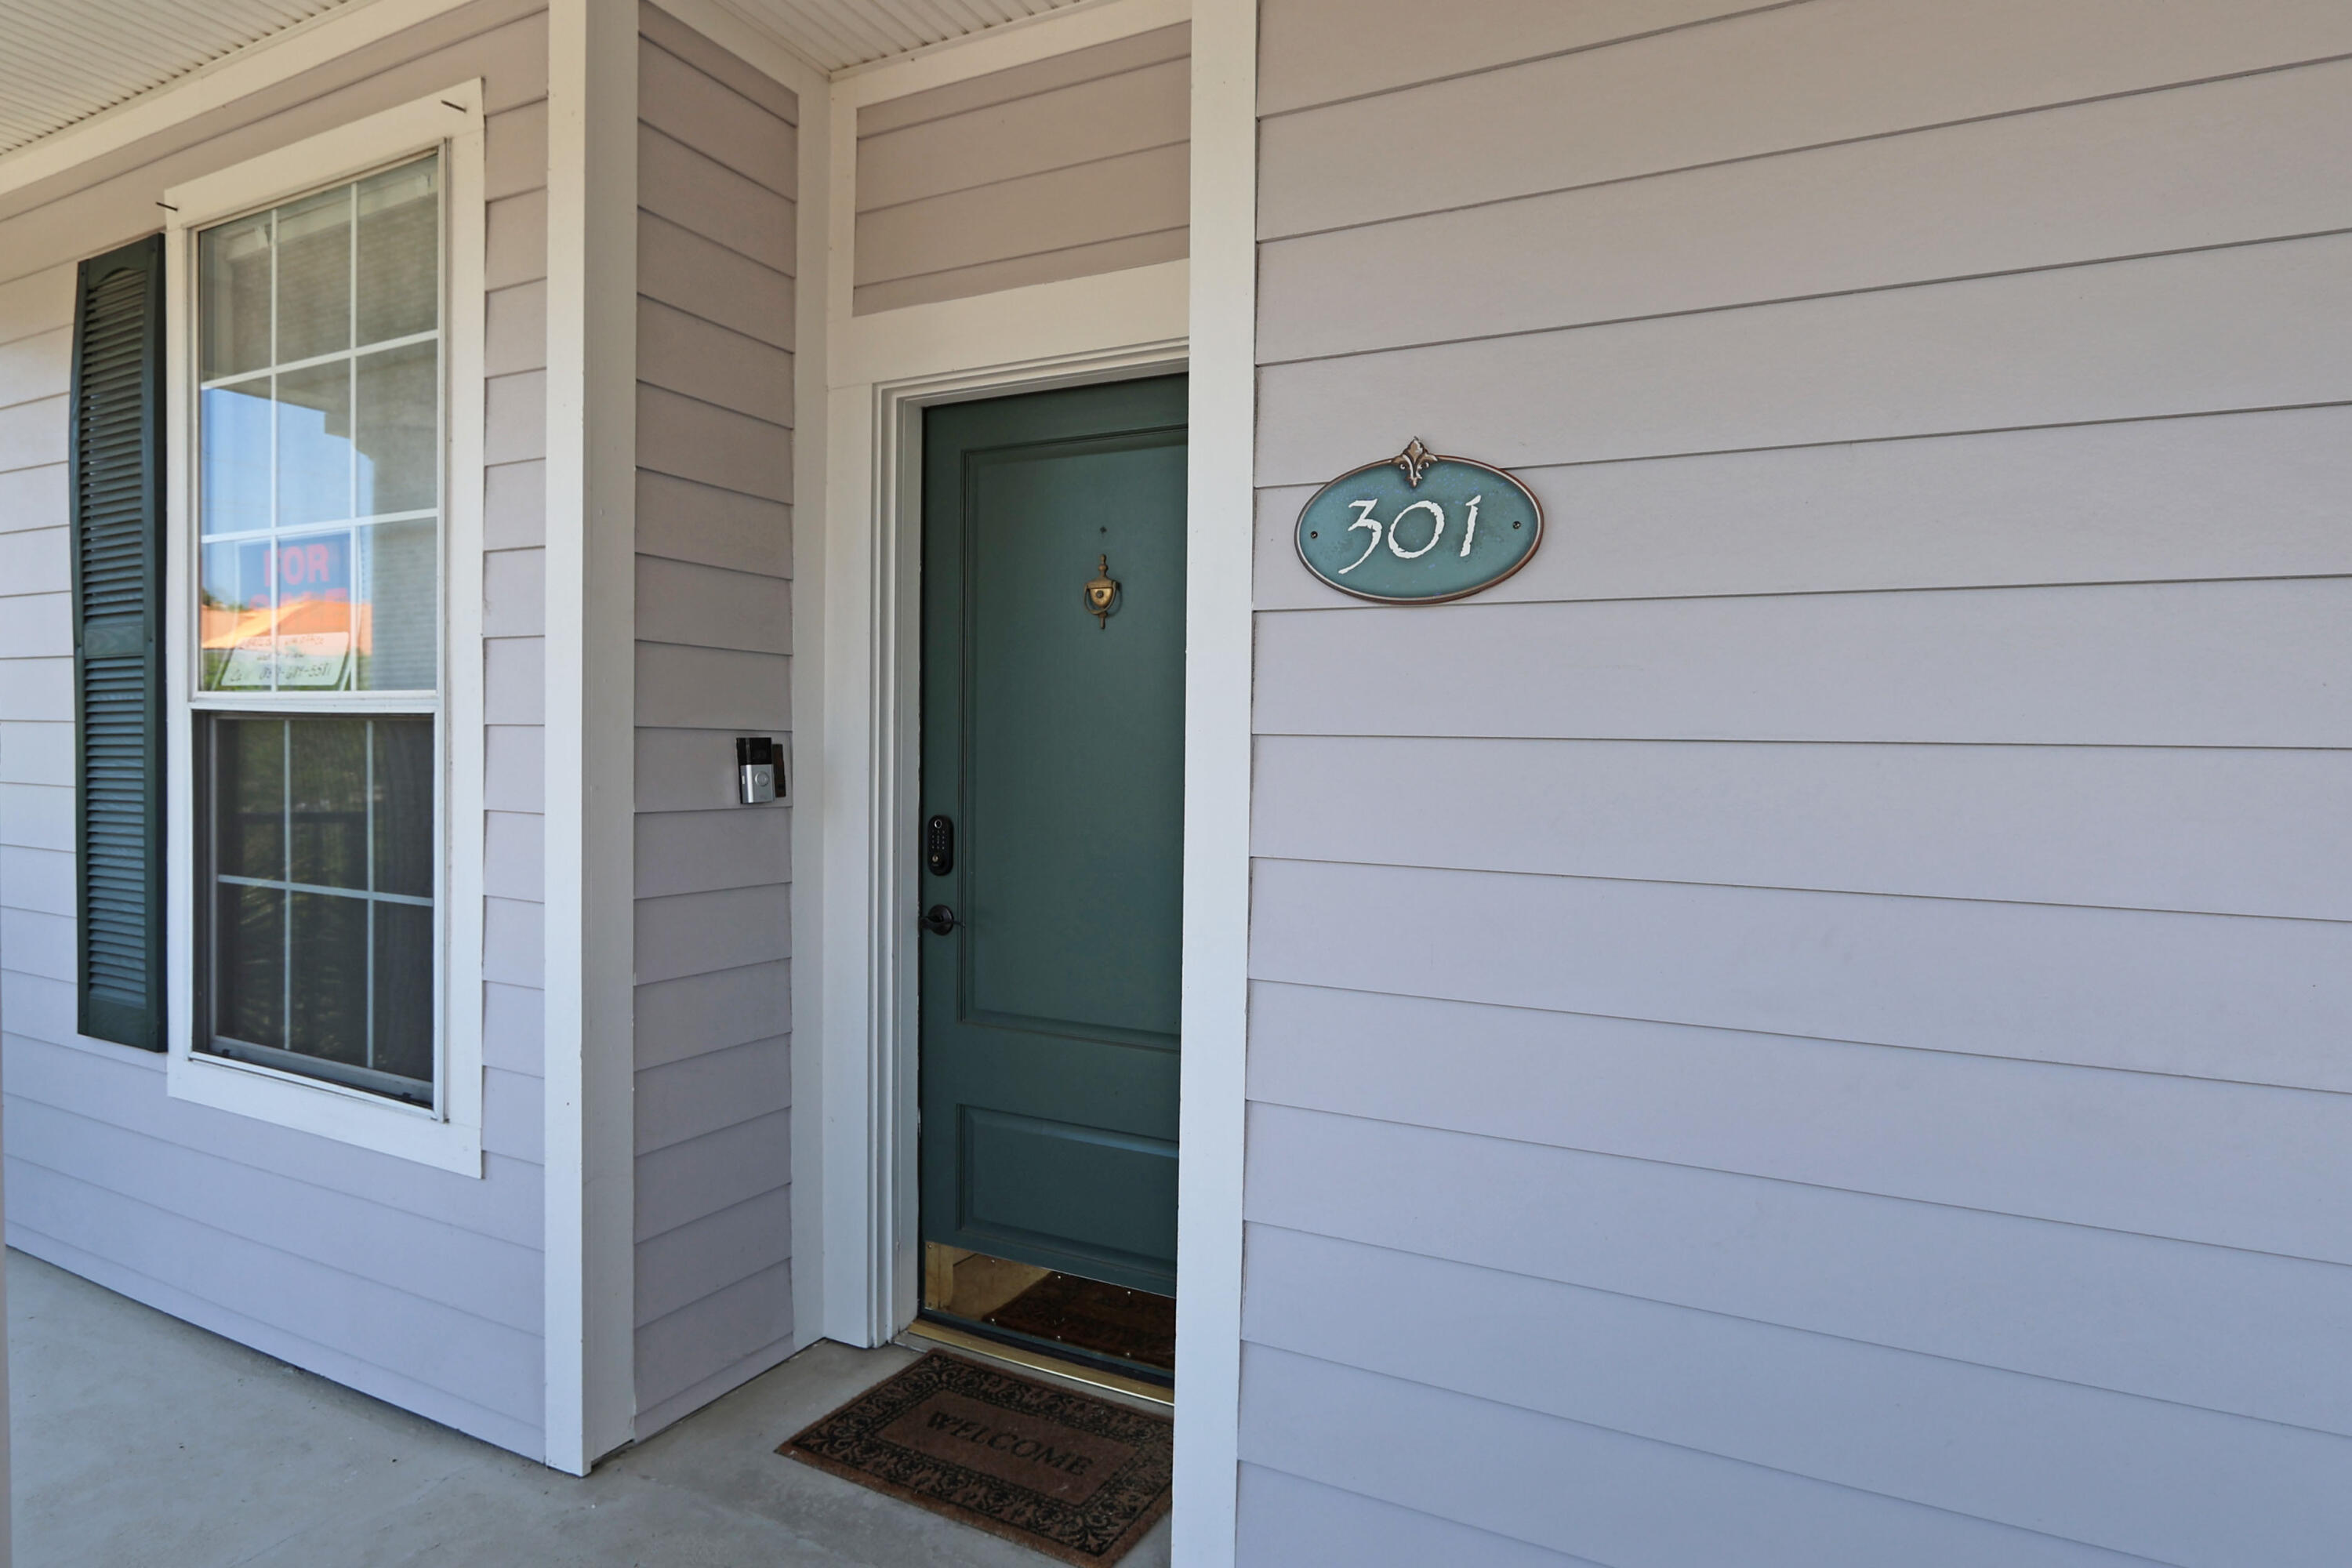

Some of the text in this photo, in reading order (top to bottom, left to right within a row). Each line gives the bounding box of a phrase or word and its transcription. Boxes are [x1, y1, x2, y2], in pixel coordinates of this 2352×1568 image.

[263, 543, 329, 587] FOR
[1338, 494, 1482, 575] 301
[927, 1410, 1094, 1476] WELCOME
